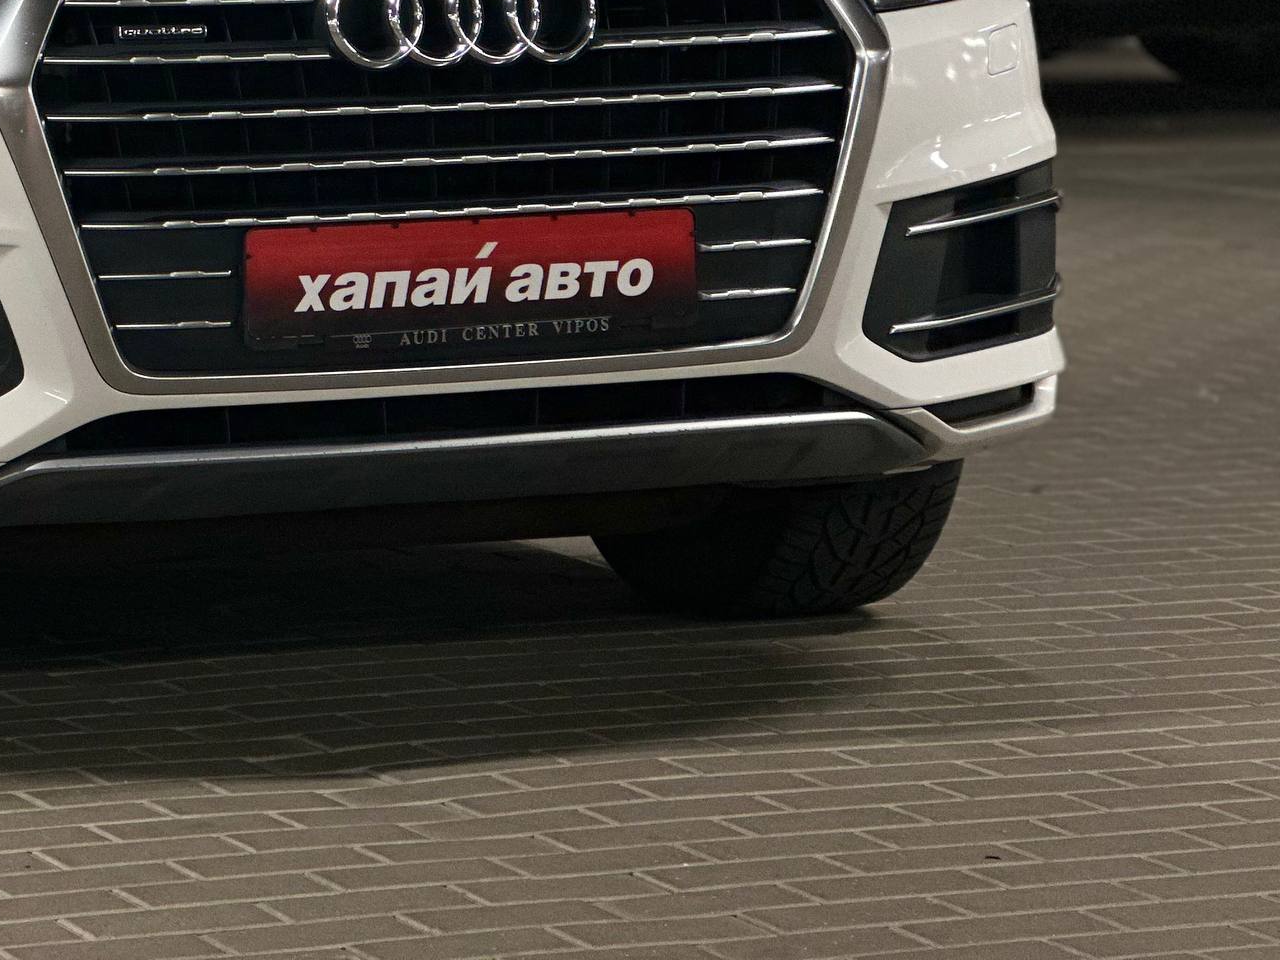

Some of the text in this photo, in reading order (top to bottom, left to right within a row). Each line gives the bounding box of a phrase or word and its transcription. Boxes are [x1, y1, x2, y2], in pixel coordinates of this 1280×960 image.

[294, 242, 655, 312] хапай авто
[400, 317, 610, 346] AUDI CENTER VIPOS
